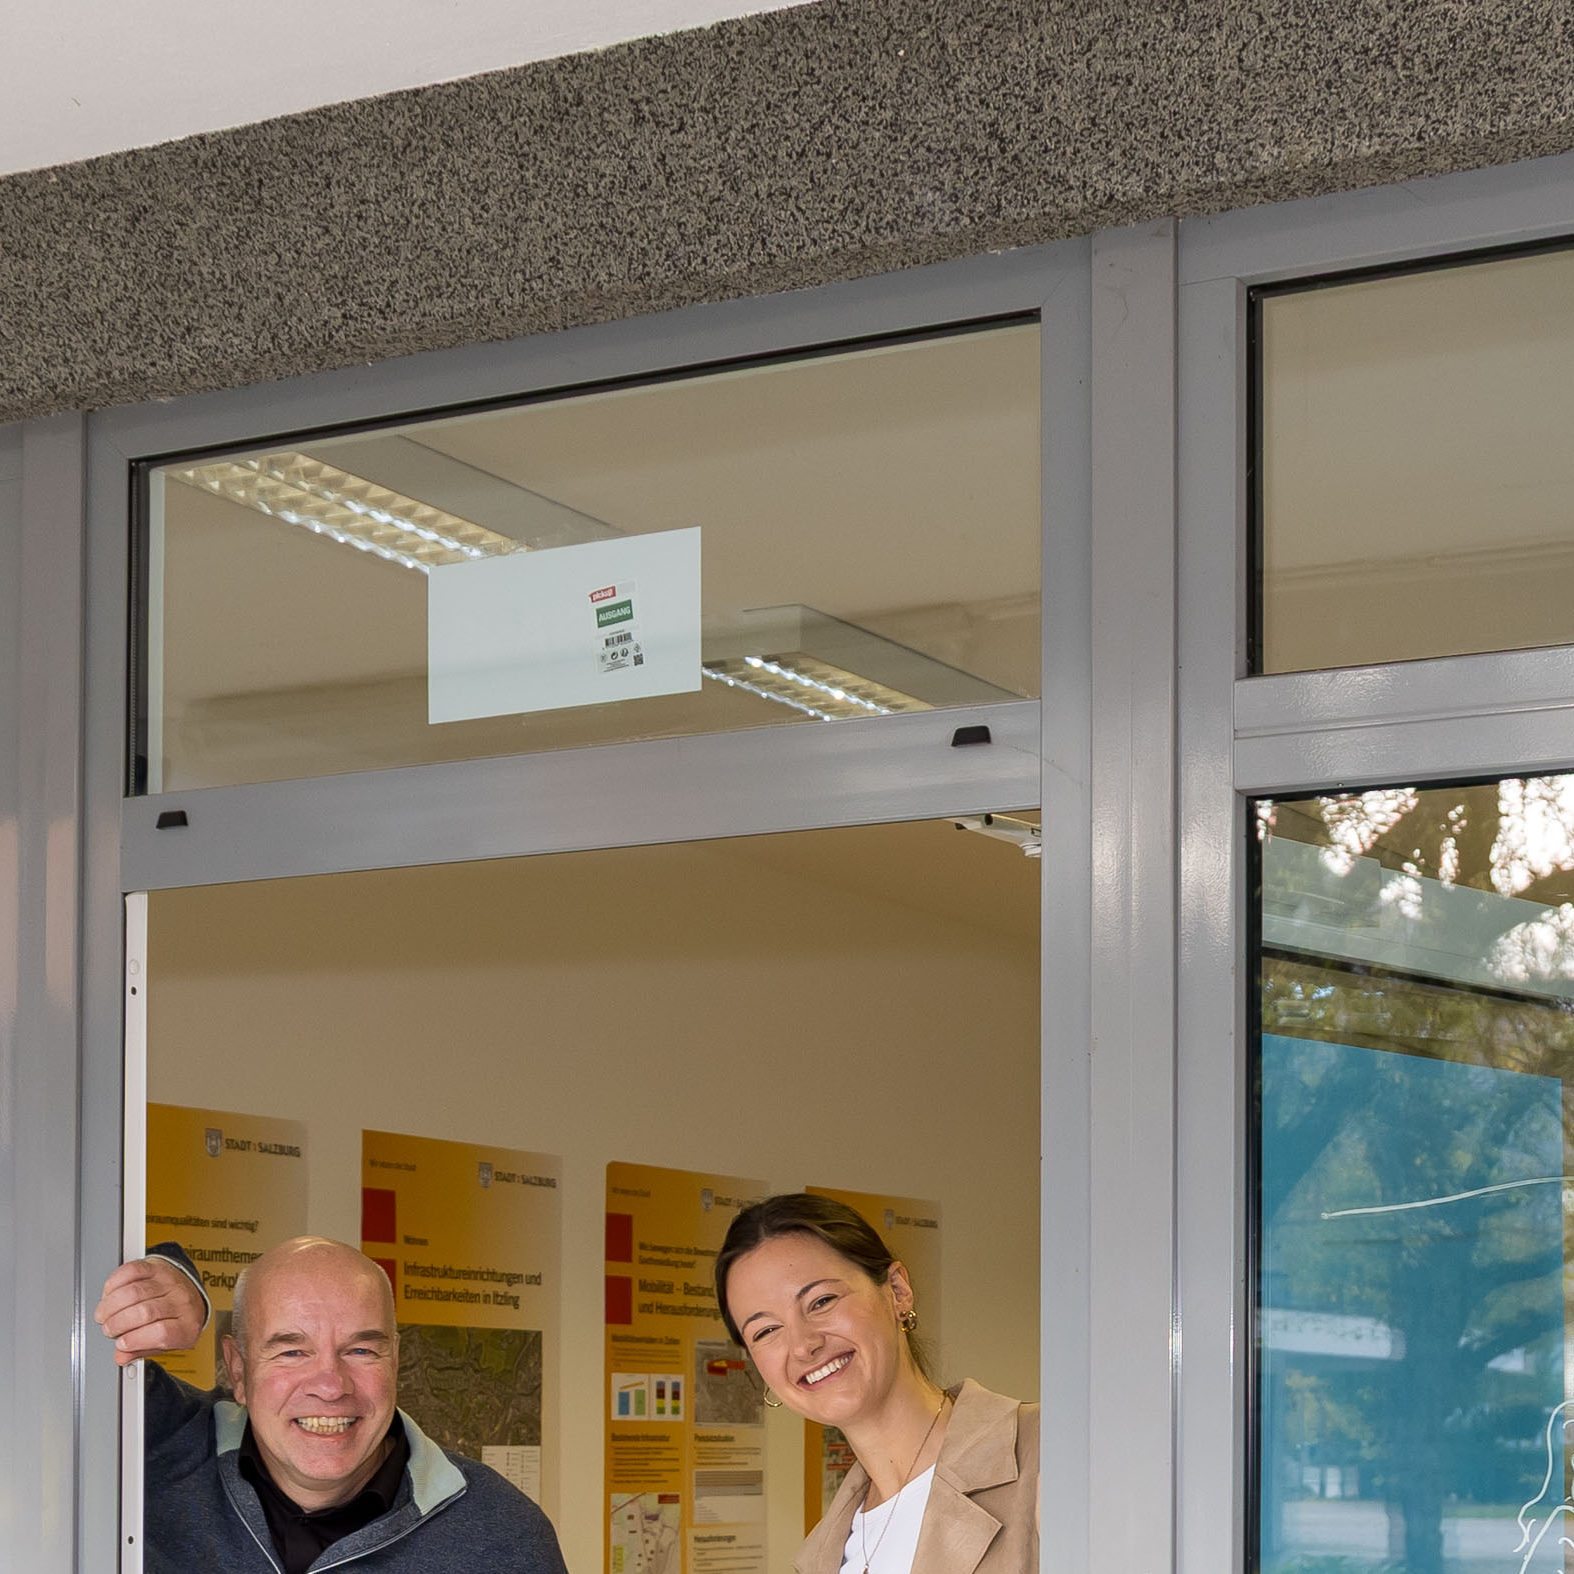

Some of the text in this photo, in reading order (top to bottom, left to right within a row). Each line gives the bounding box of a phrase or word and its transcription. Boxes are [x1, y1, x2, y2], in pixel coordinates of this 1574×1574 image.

[599, 607, 631, 622] AUSGANG
[225, 1138, 301, 1157] STADT SALZBURG
[494, 1171, 556, 1188] STADT SALZBURG
[404, 1261, 542, 1287] Infrastruktureinrichtungen und
[404, 1284, 520, 1310] Erreichbarkeiten in Itzling
